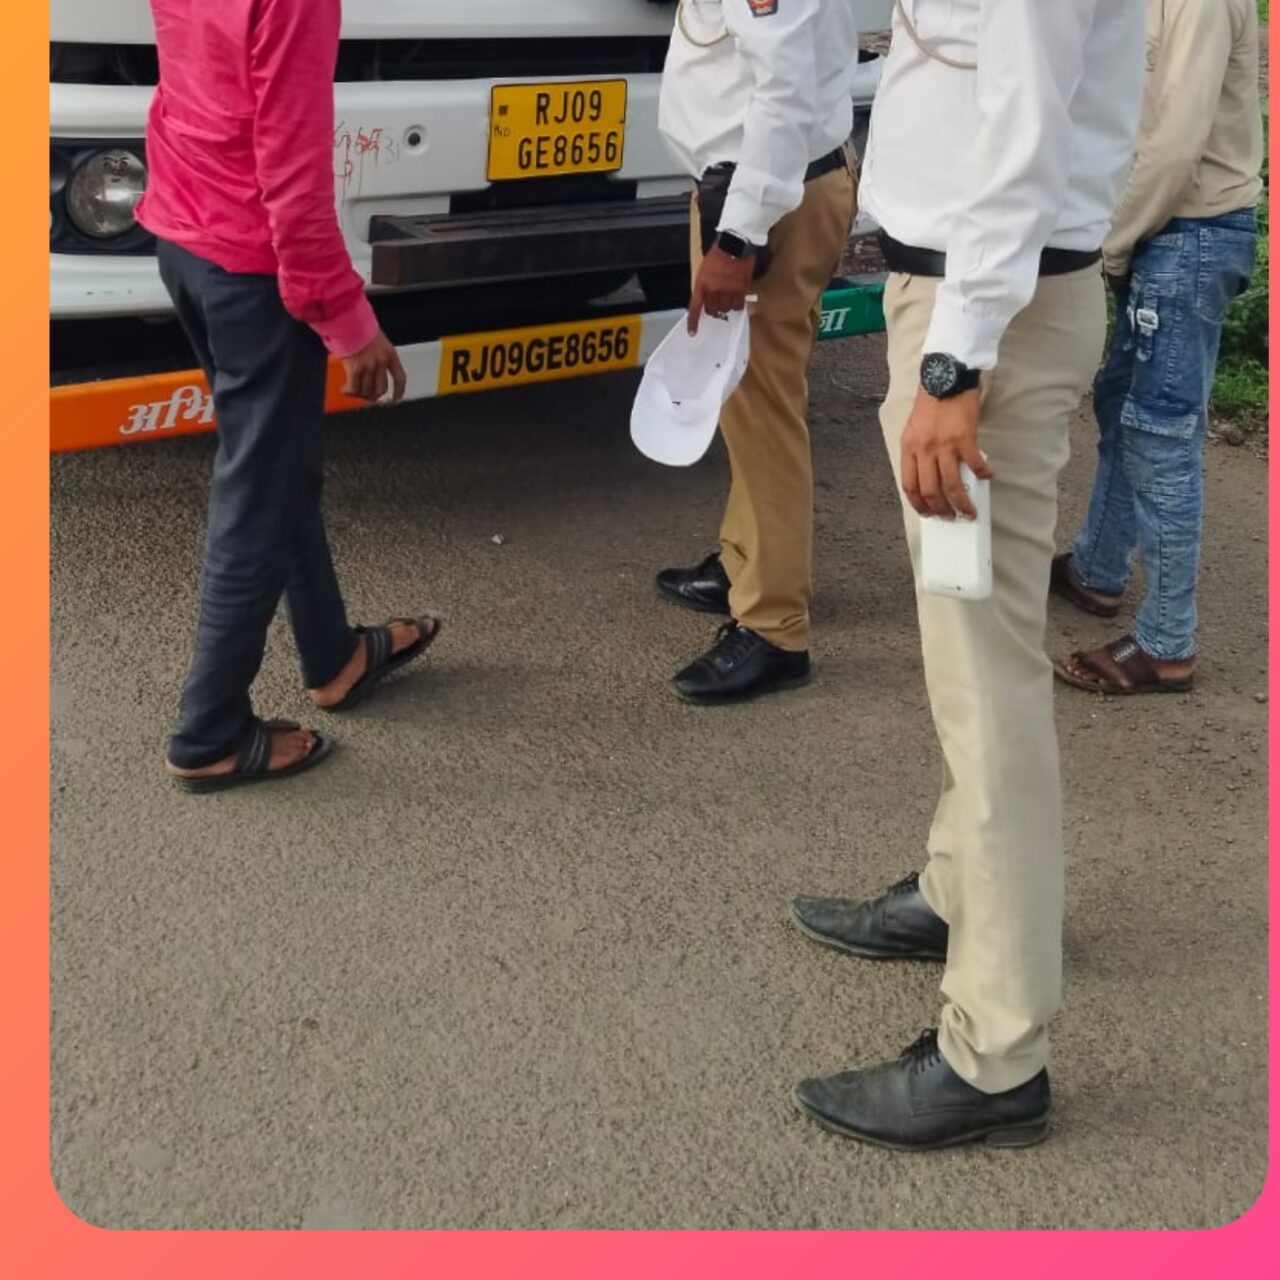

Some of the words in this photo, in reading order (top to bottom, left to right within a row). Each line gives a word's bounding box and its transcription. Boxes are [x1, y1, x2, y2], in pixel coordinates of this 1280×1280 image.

[535, 89, 602, 125] RJ09
[517, 131, 618, 170] GE8656
[451, 325, 630, 386] RJ09GE8656
